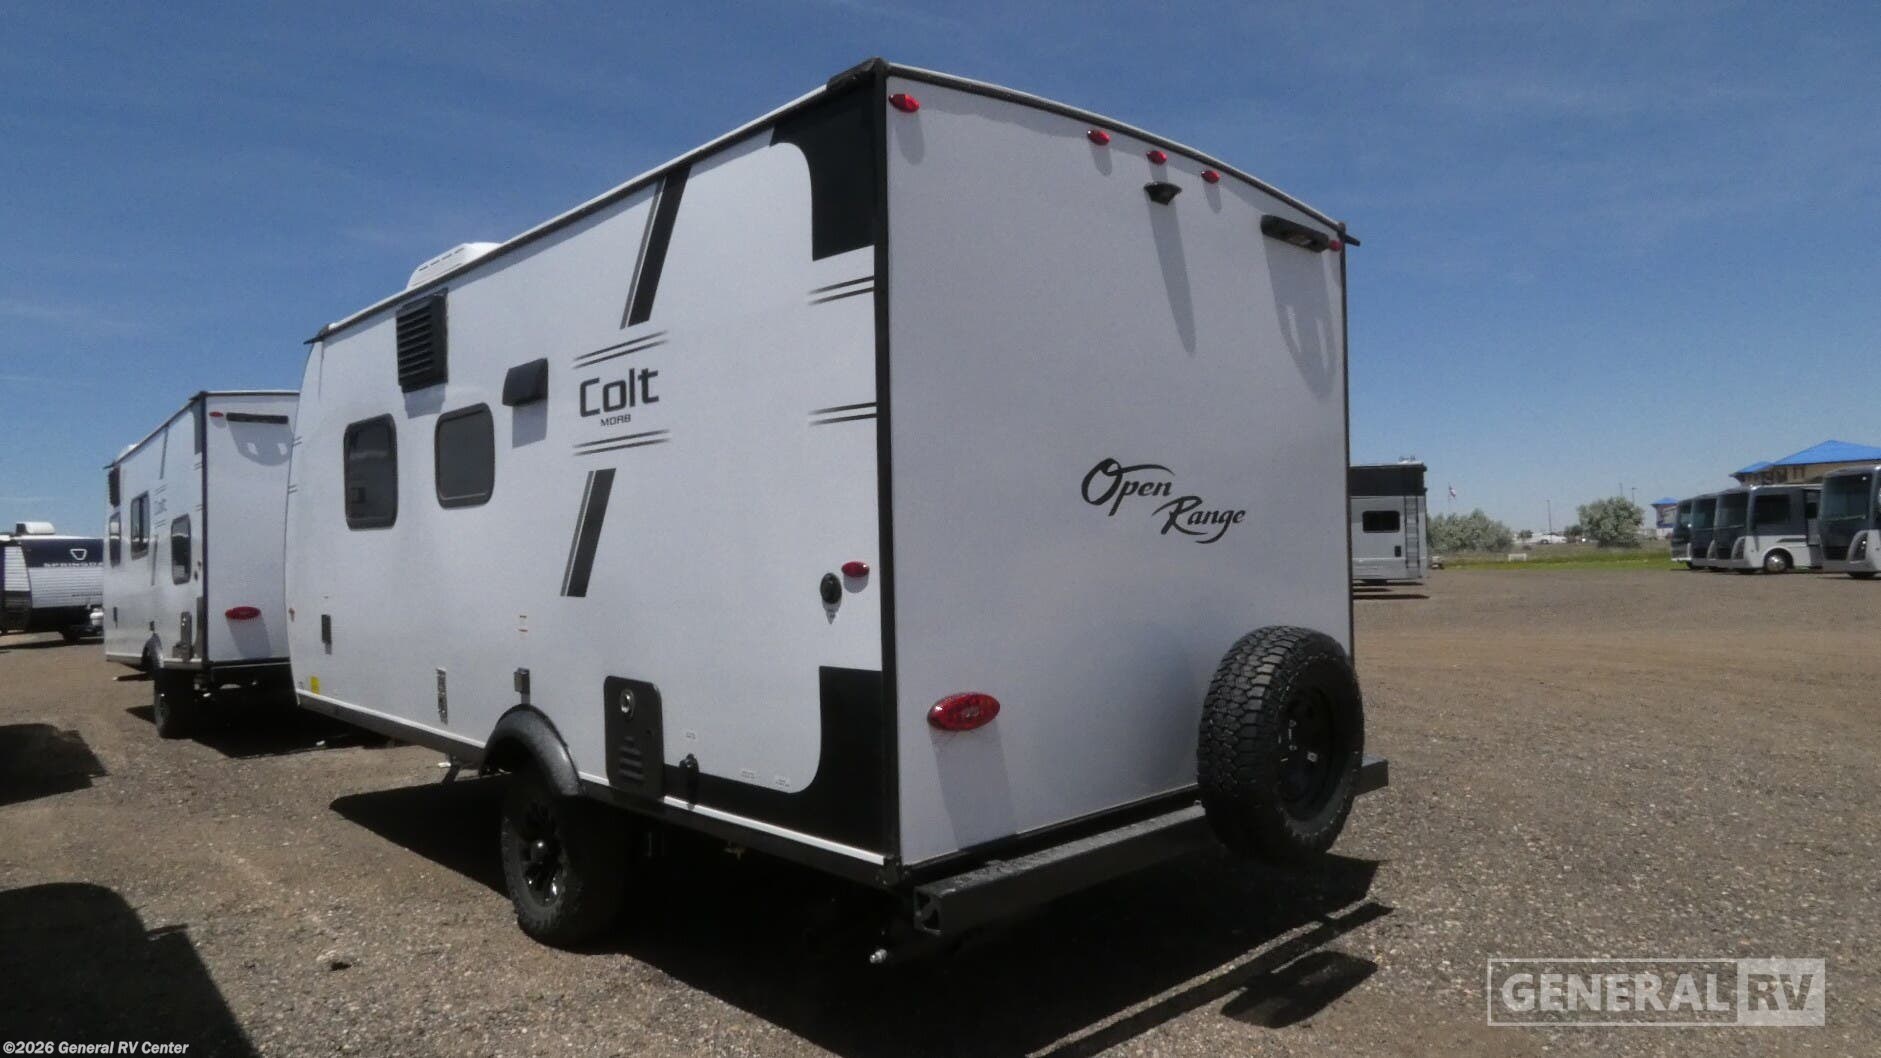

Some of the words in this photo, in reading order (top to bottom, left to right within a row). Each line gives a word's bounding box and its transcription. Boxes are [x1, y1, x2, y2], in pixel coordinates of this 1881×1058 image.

[580, 367, 660, 418] Colt
[1081, 457, 1176, 517] Open
[1151, 495, 1247, 545] Range
